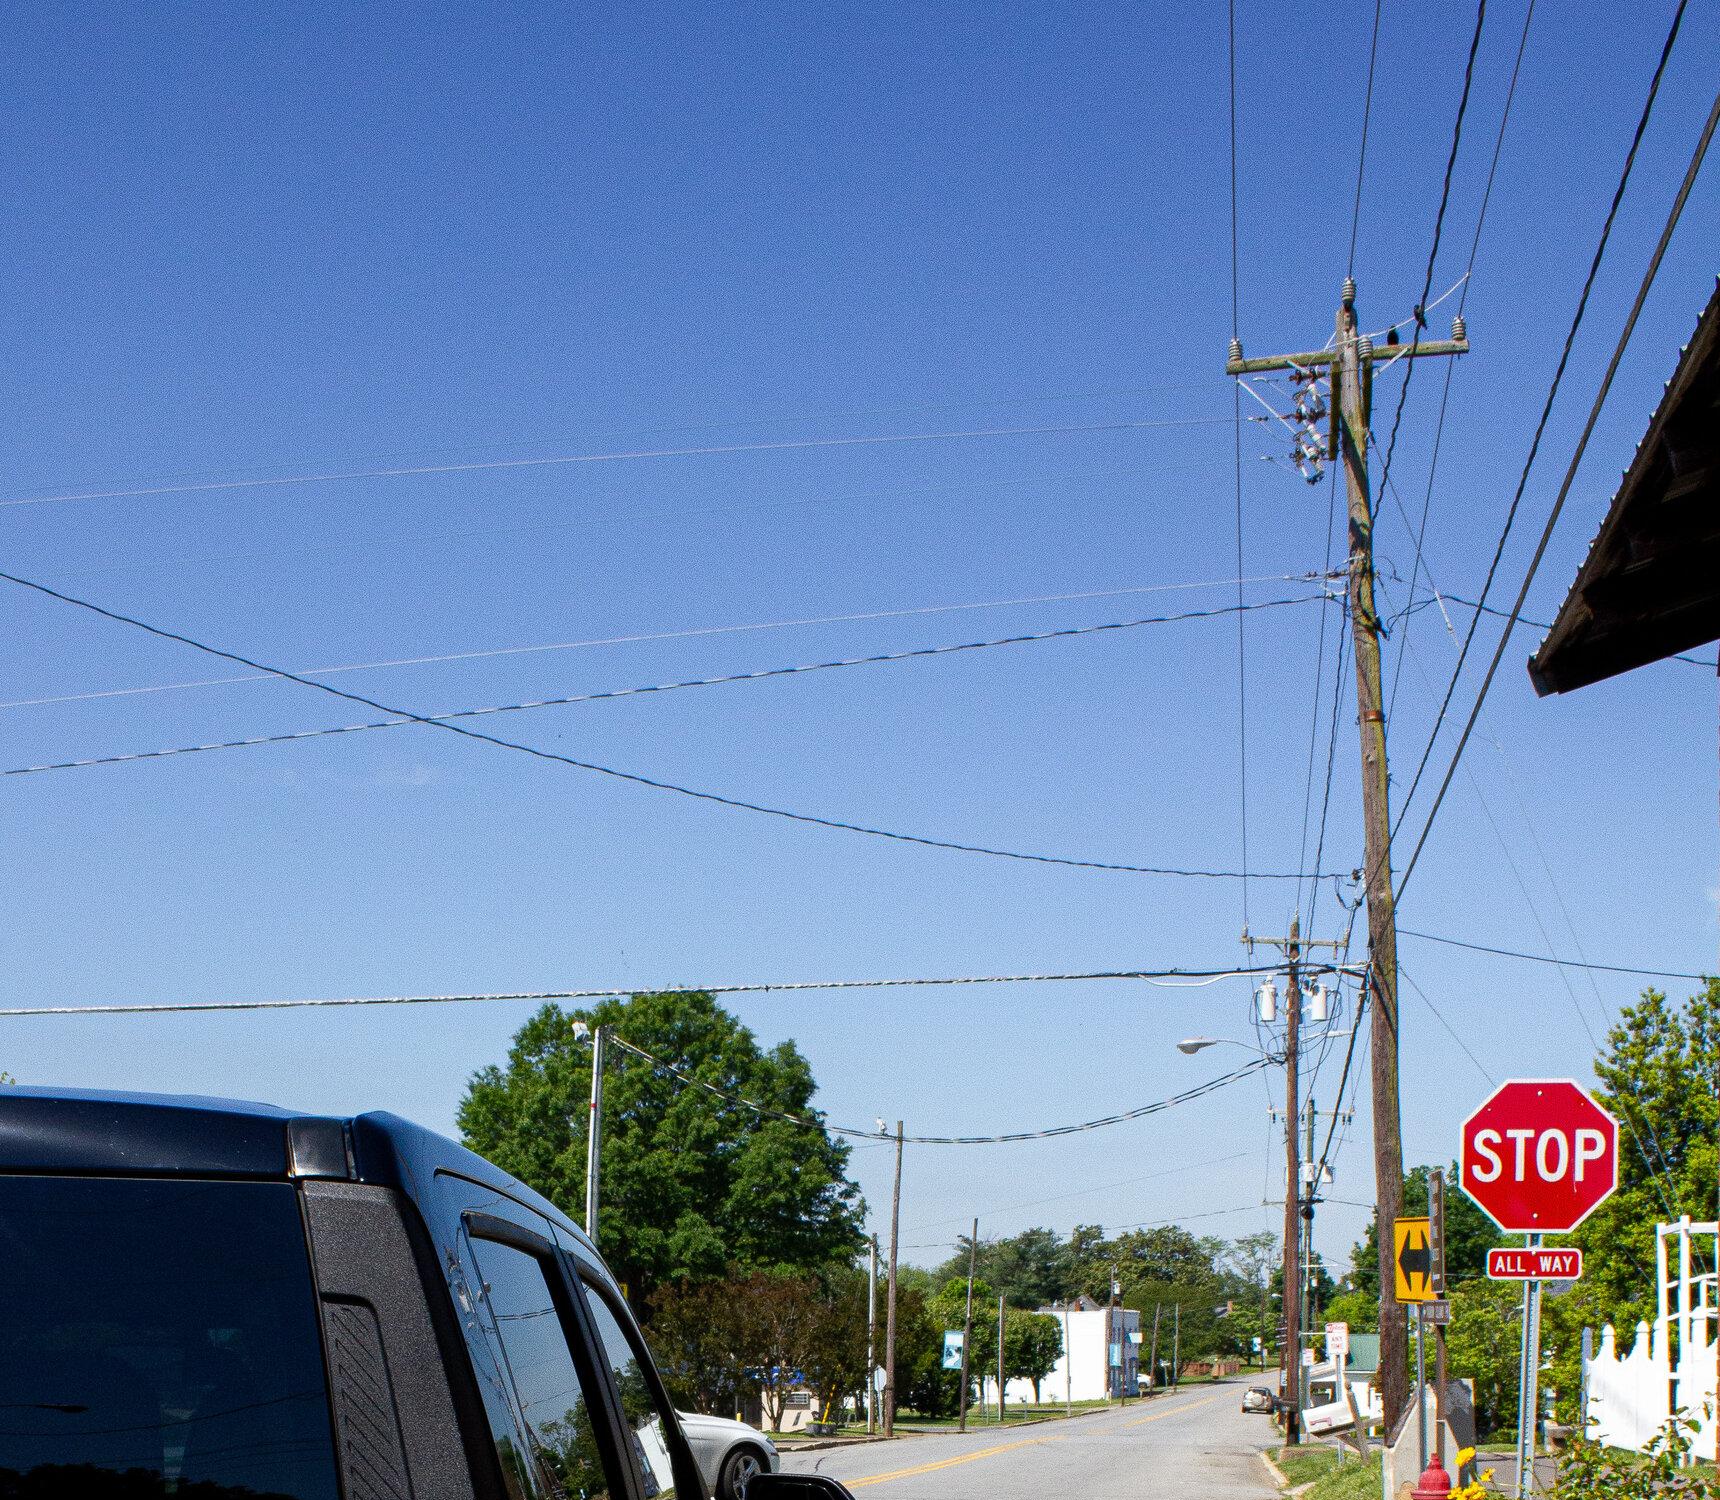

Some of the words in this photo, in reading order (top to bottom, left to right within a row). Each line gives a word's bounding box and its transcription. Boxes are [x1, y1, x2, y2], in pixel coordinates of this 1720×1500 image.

[1471, 1128, 1606, 1183] STOP
[1494, 1255, 1526, 1272] ALL
[1539, 1255, 1574, 1272] WAY
